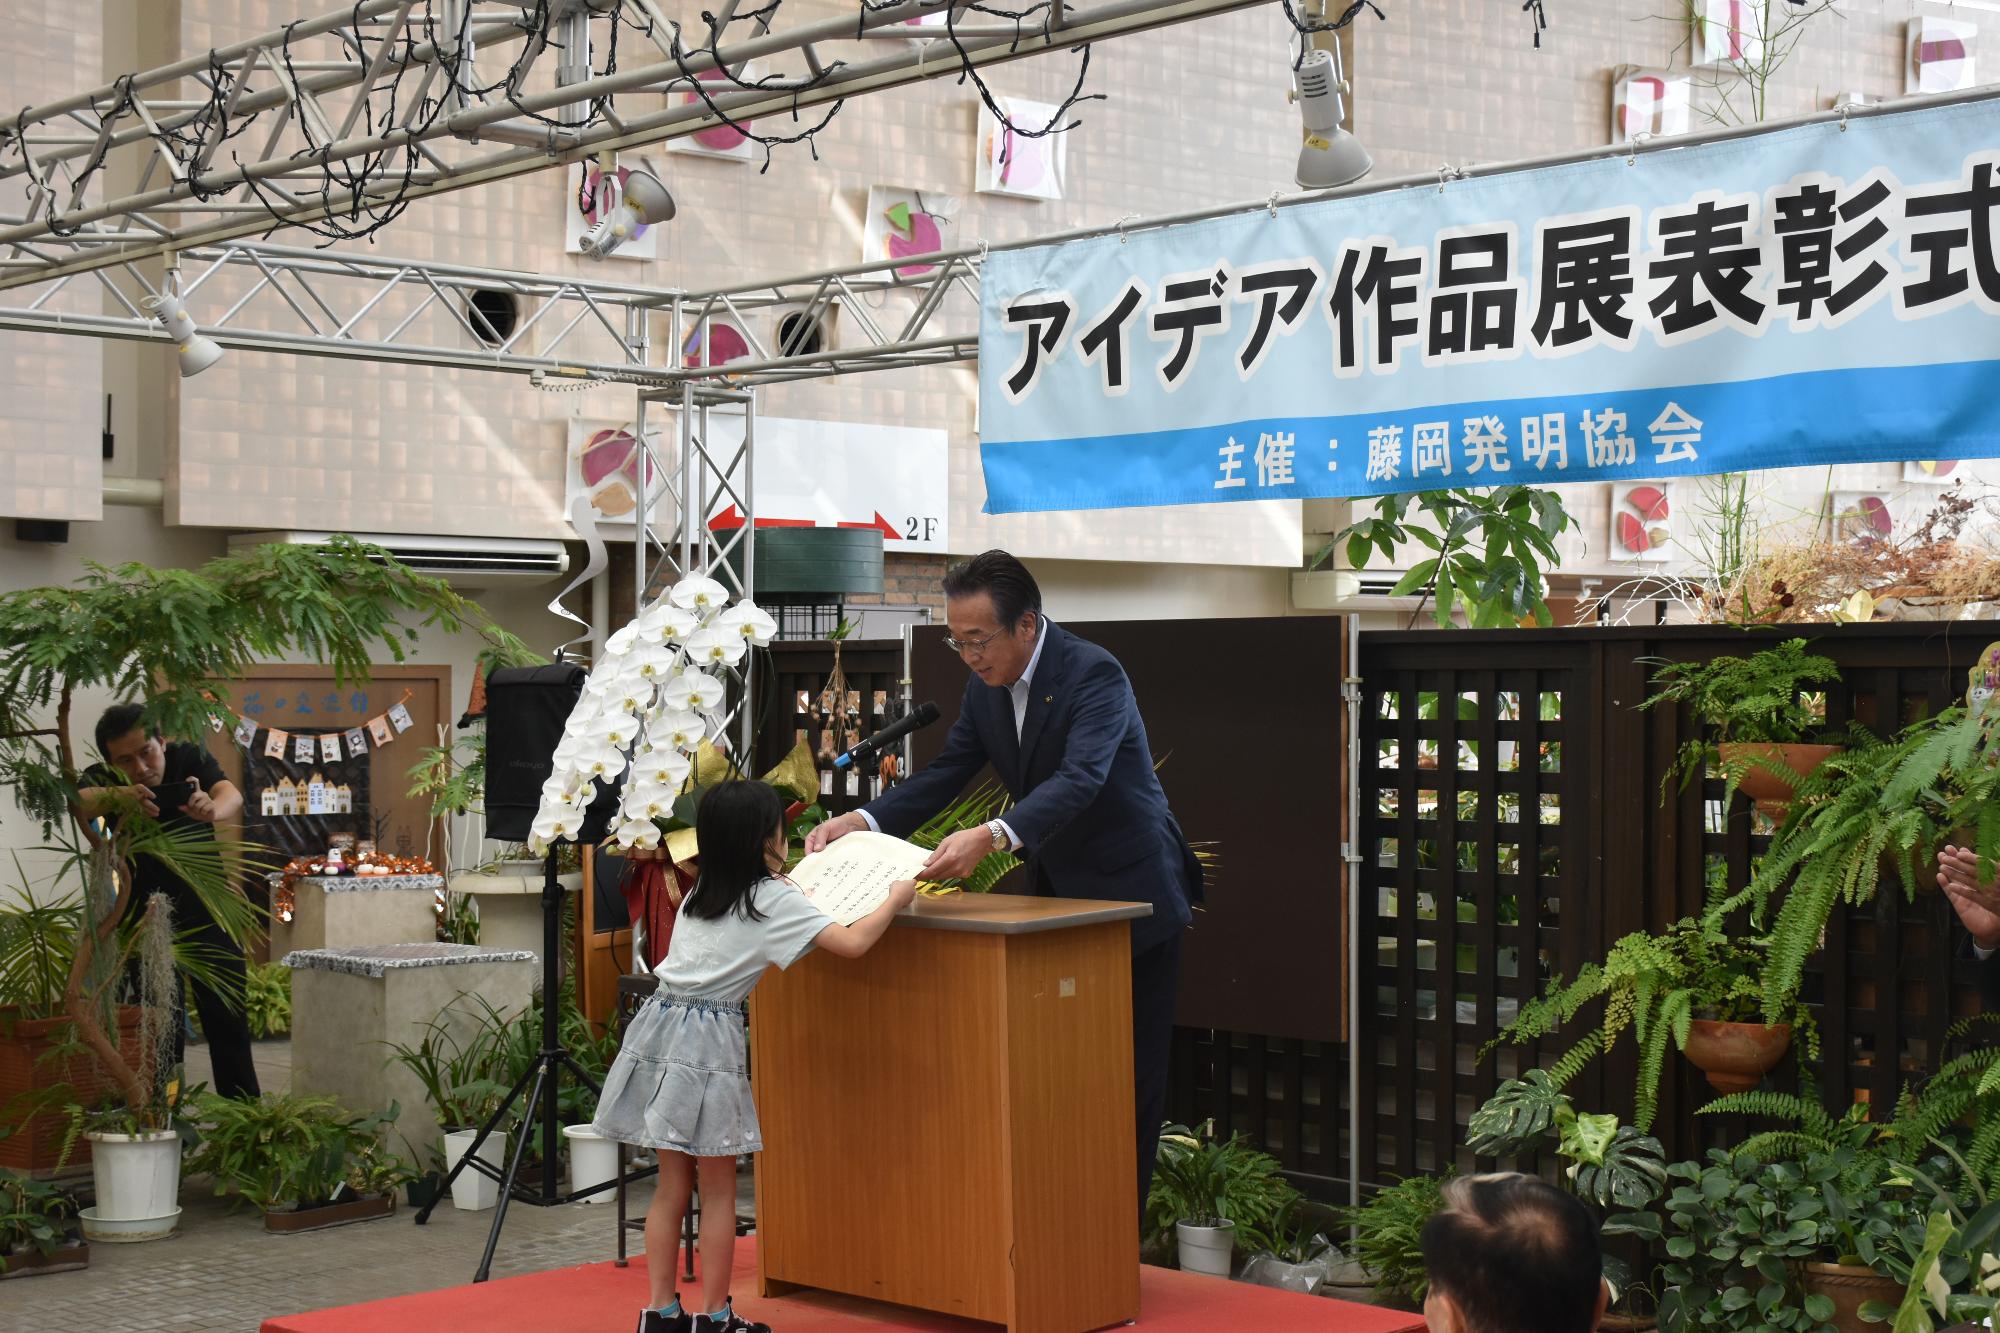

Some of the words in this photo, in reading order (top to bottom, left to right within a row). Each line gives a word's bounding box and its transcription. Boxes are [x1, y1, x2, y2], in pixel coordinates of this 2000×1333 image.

[1007, 162, 2000, 396] アイデア作品展表彰式
[906, 516, 939, 541] 2F
